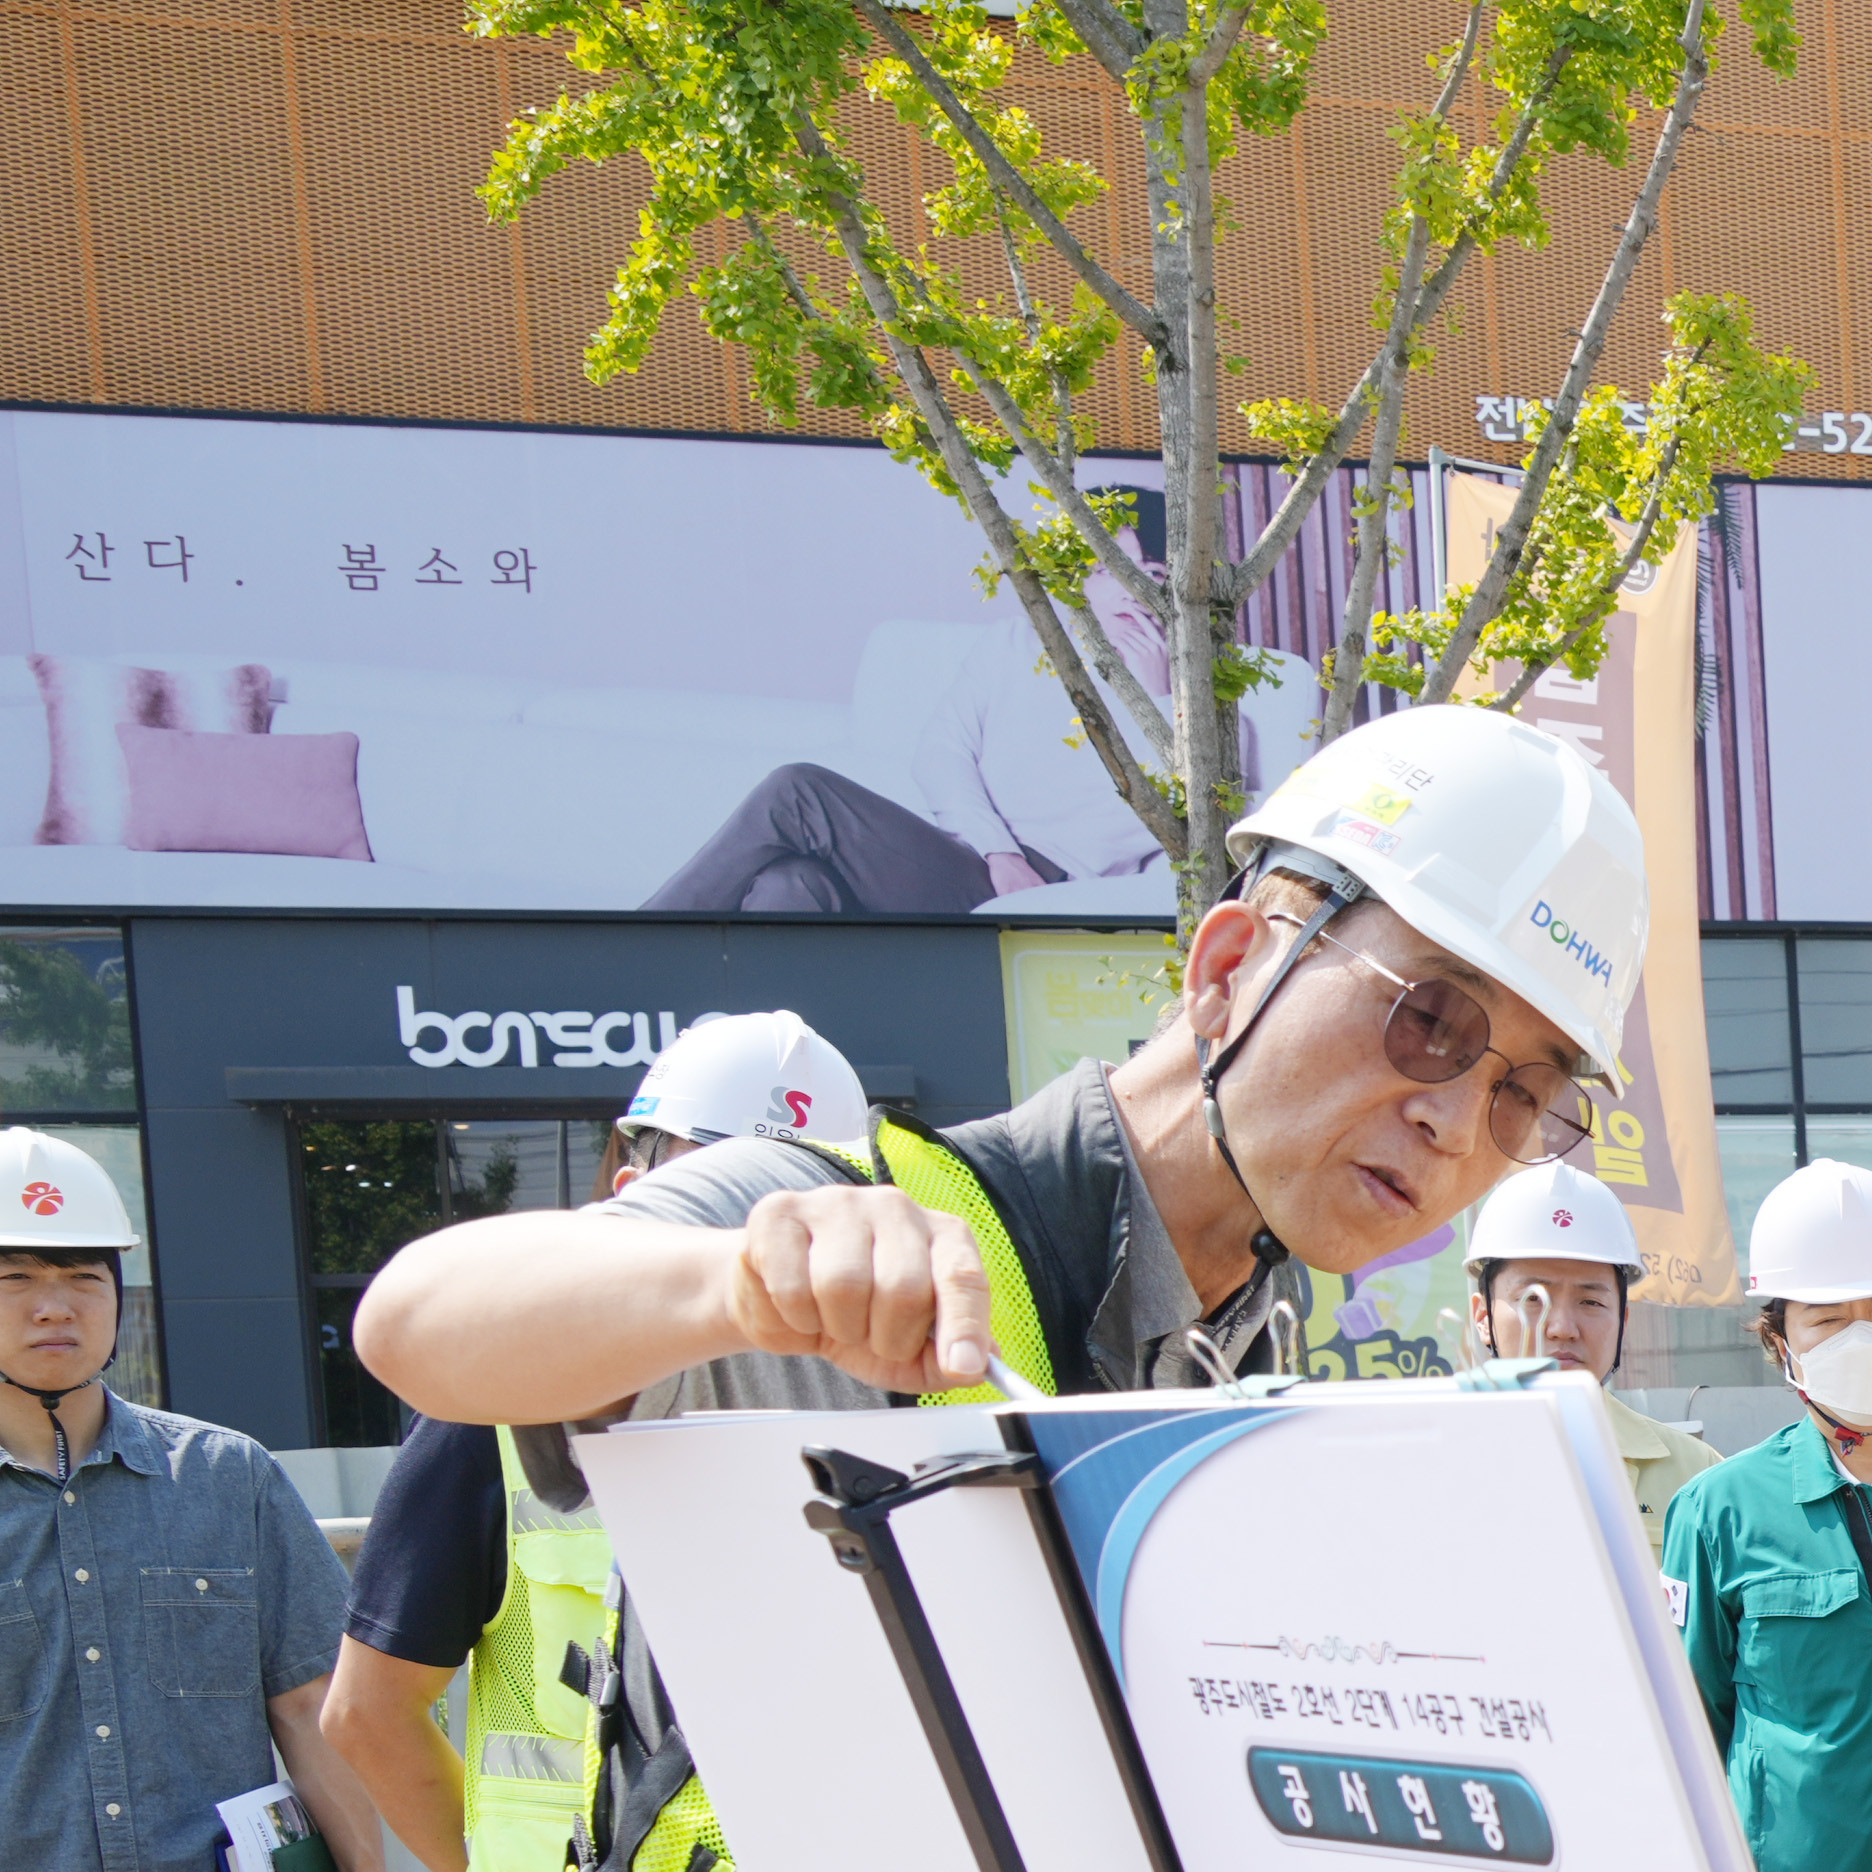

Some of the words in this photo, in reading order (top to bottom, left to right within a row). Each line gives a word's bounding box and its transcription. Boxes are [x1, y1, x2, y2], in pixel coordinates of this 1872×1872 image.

[336, 543, 539, 594] 봄소와
[1529, 899, 1614, 989] DOHWA
[1188, 1677, 1288, 1719] 광주도시철도
[1291, 1684, 1341, 1726] 2호선
[1345, 1690, 1398, 1731] 2단계
[1406, 1693, 1464, 1736] 14공구
[1472, 1696, 1555, 1744] 건설공사
